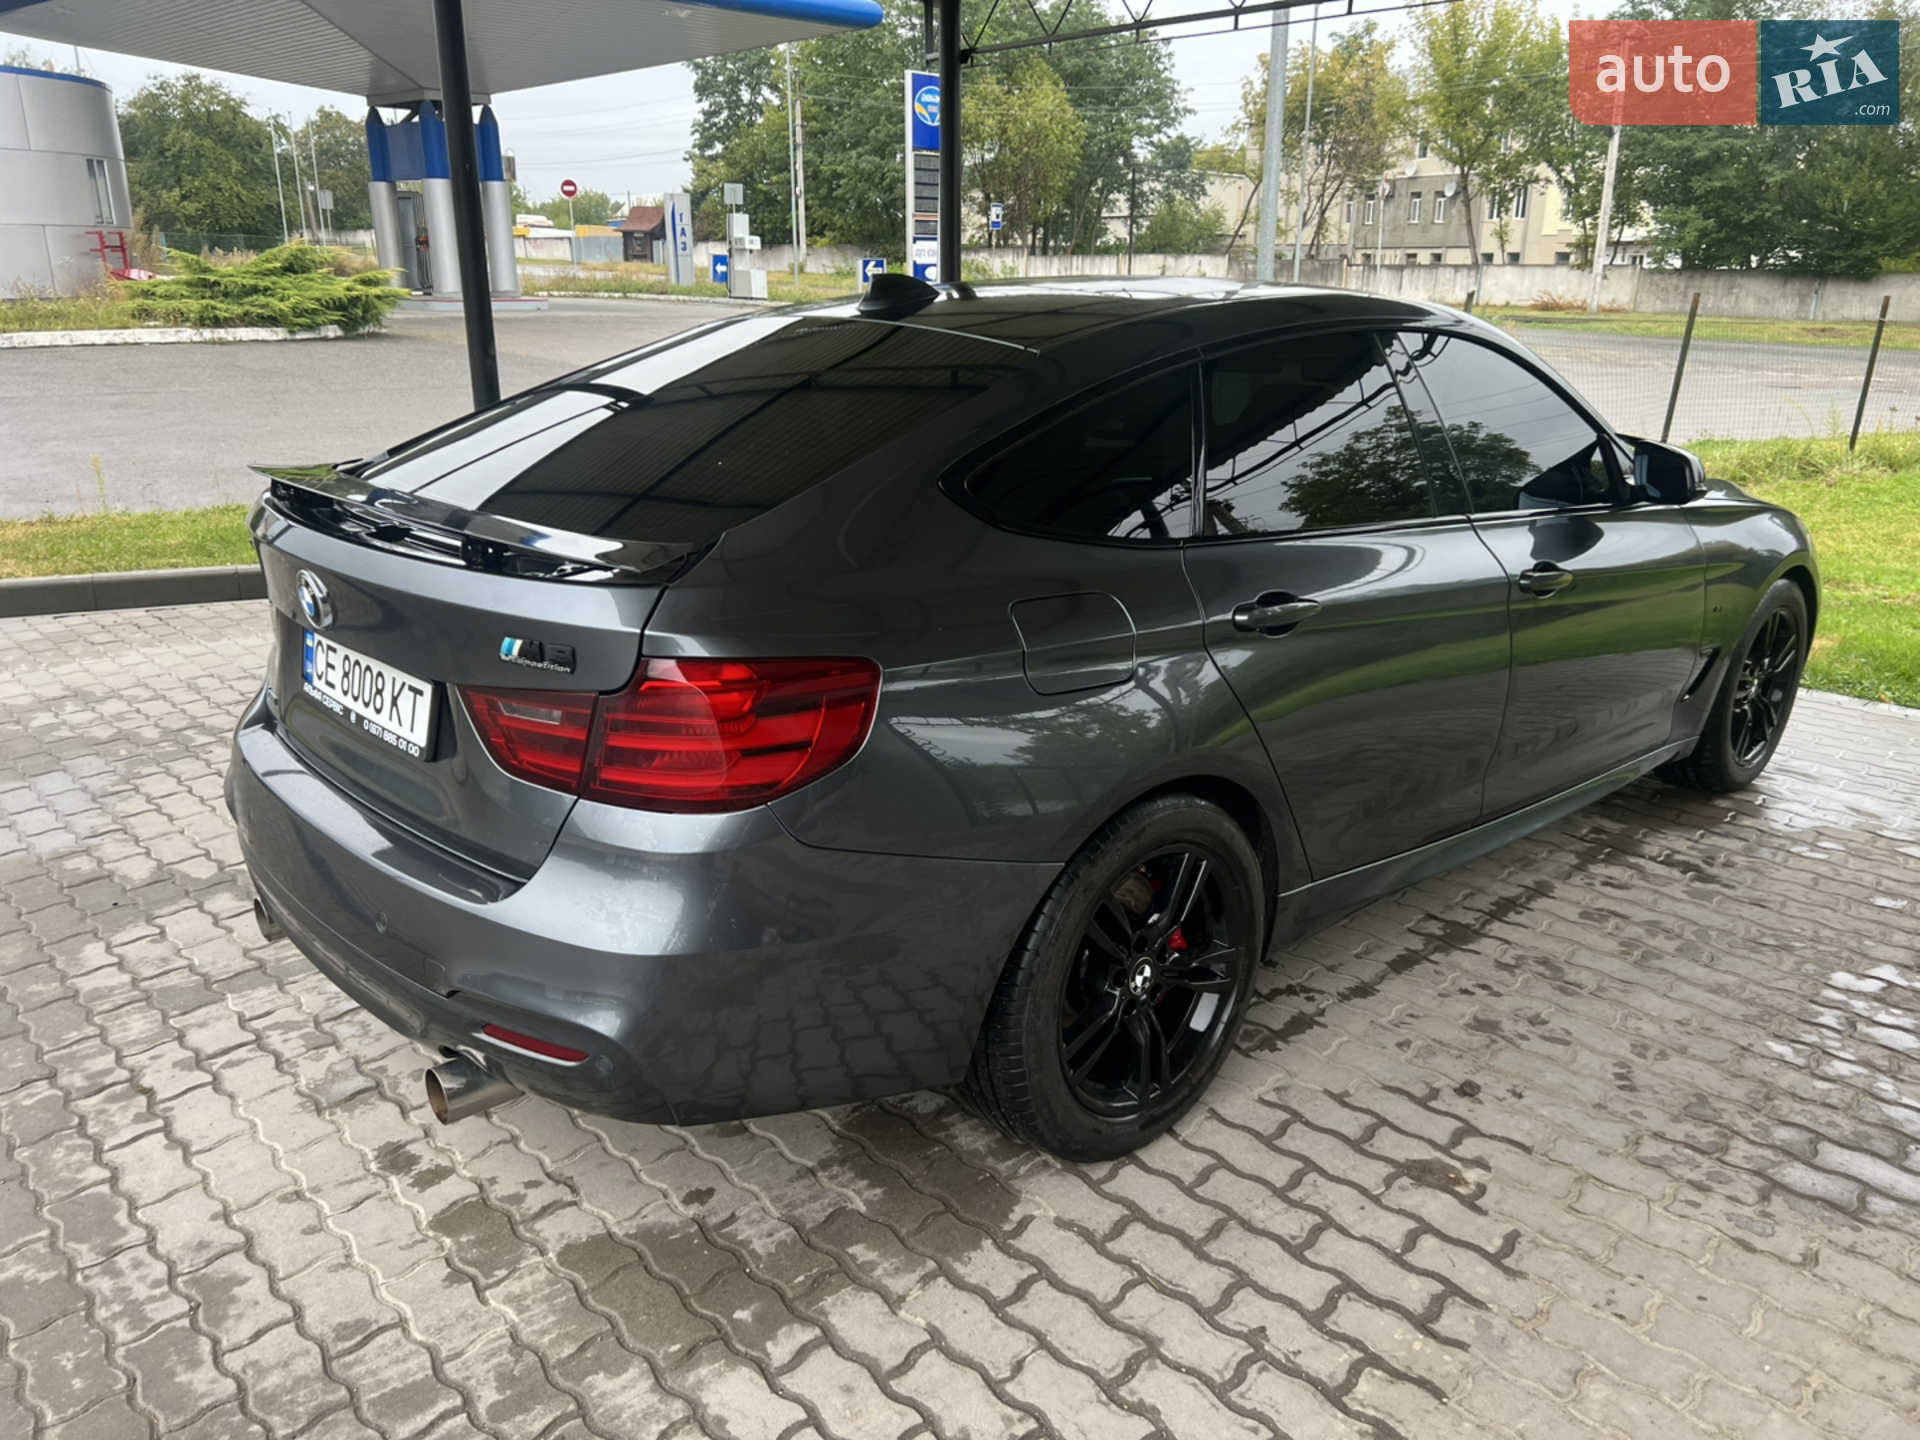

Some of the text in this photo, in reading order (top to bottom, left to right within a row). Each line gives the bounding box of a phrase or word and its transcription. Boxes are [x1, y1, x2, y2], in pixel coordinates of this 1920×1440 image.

[679, 212, 687, 252] ГАЗ
[315, 639, 424, 733] CE 8008 KT
